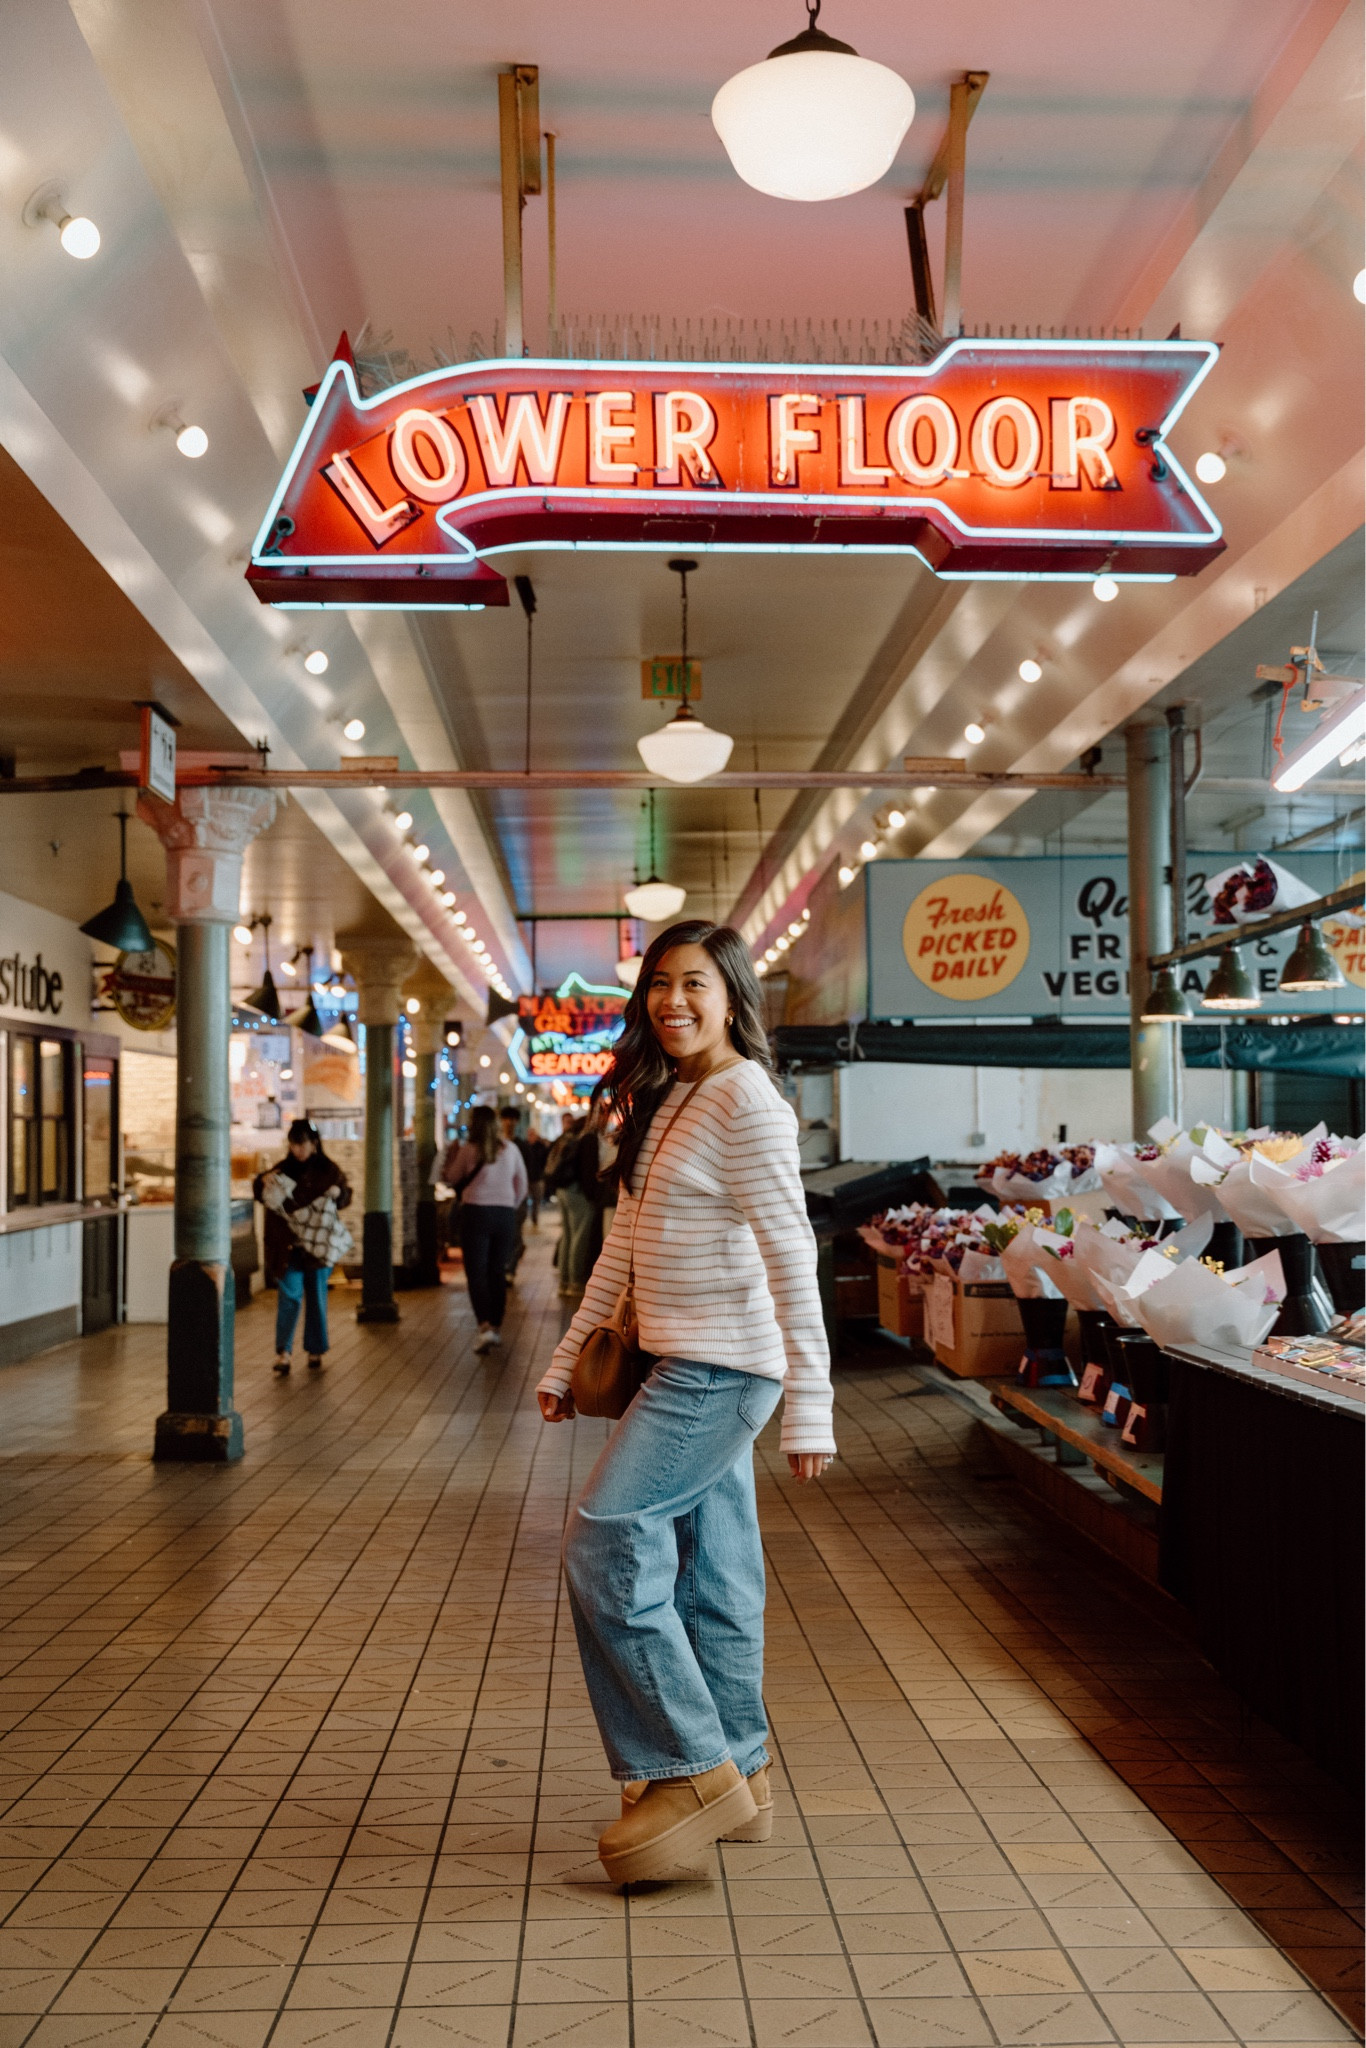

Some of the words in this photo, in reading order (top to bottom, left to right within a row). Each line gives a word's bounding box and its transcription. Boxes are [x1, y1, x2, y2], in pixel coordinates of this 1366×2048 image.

[319, 391, 726, 550] LOWER
[767, 393, 1122, 492] FLOOR
[925, 886, 1007, 930] Fresh
[917, 926, 1018, 958] PICKED
[930, 955, 1008, 983] DAILY
